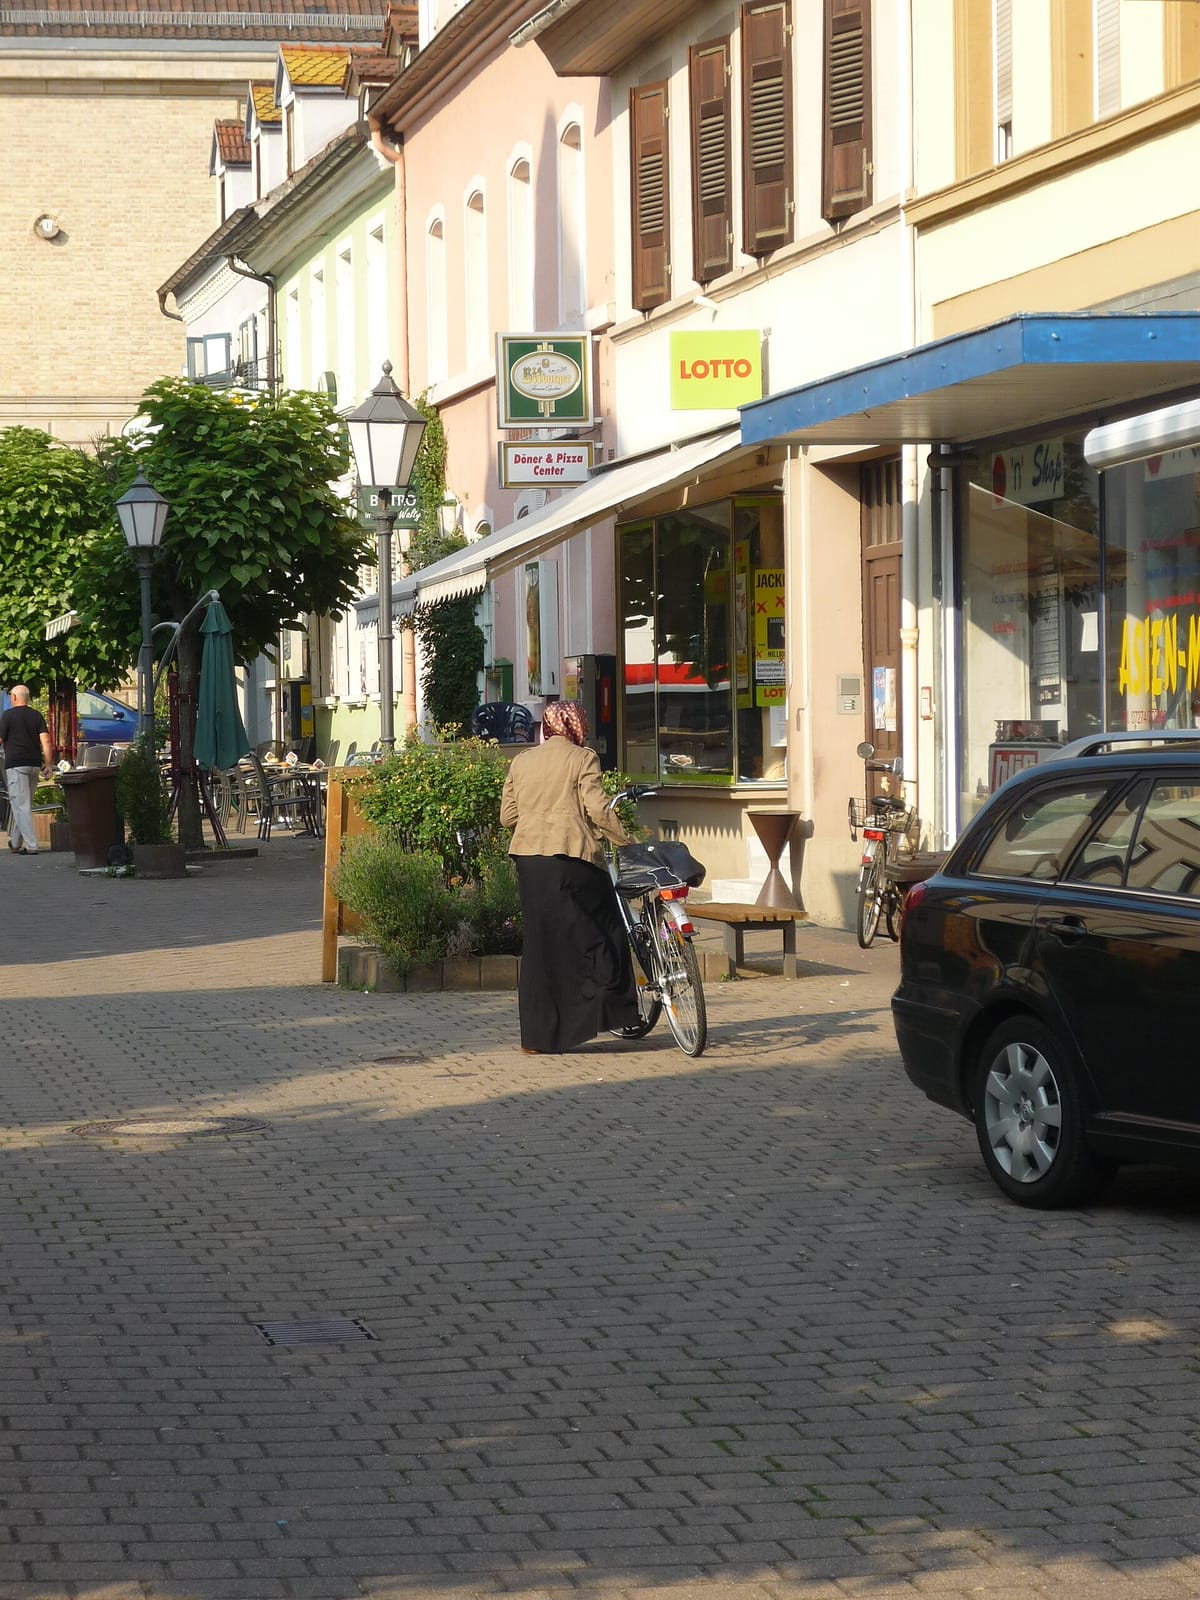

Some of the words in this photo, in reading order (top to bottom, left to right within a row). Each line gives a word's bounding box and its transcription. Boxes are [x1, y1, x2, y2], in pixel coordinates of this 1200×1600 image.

[680, 359, 752, 379] LOTTO
[514, 453, 543, 464] Döner
[545, 453, 553, 464] &
[556, 452, 583, 464] Pizza
[533, 465, 565, 476] Center
[1032, 443, 1062, 496] Shop
[370, 494, 417, 507] BTRO
[763, 688, 785, 699] LOT
